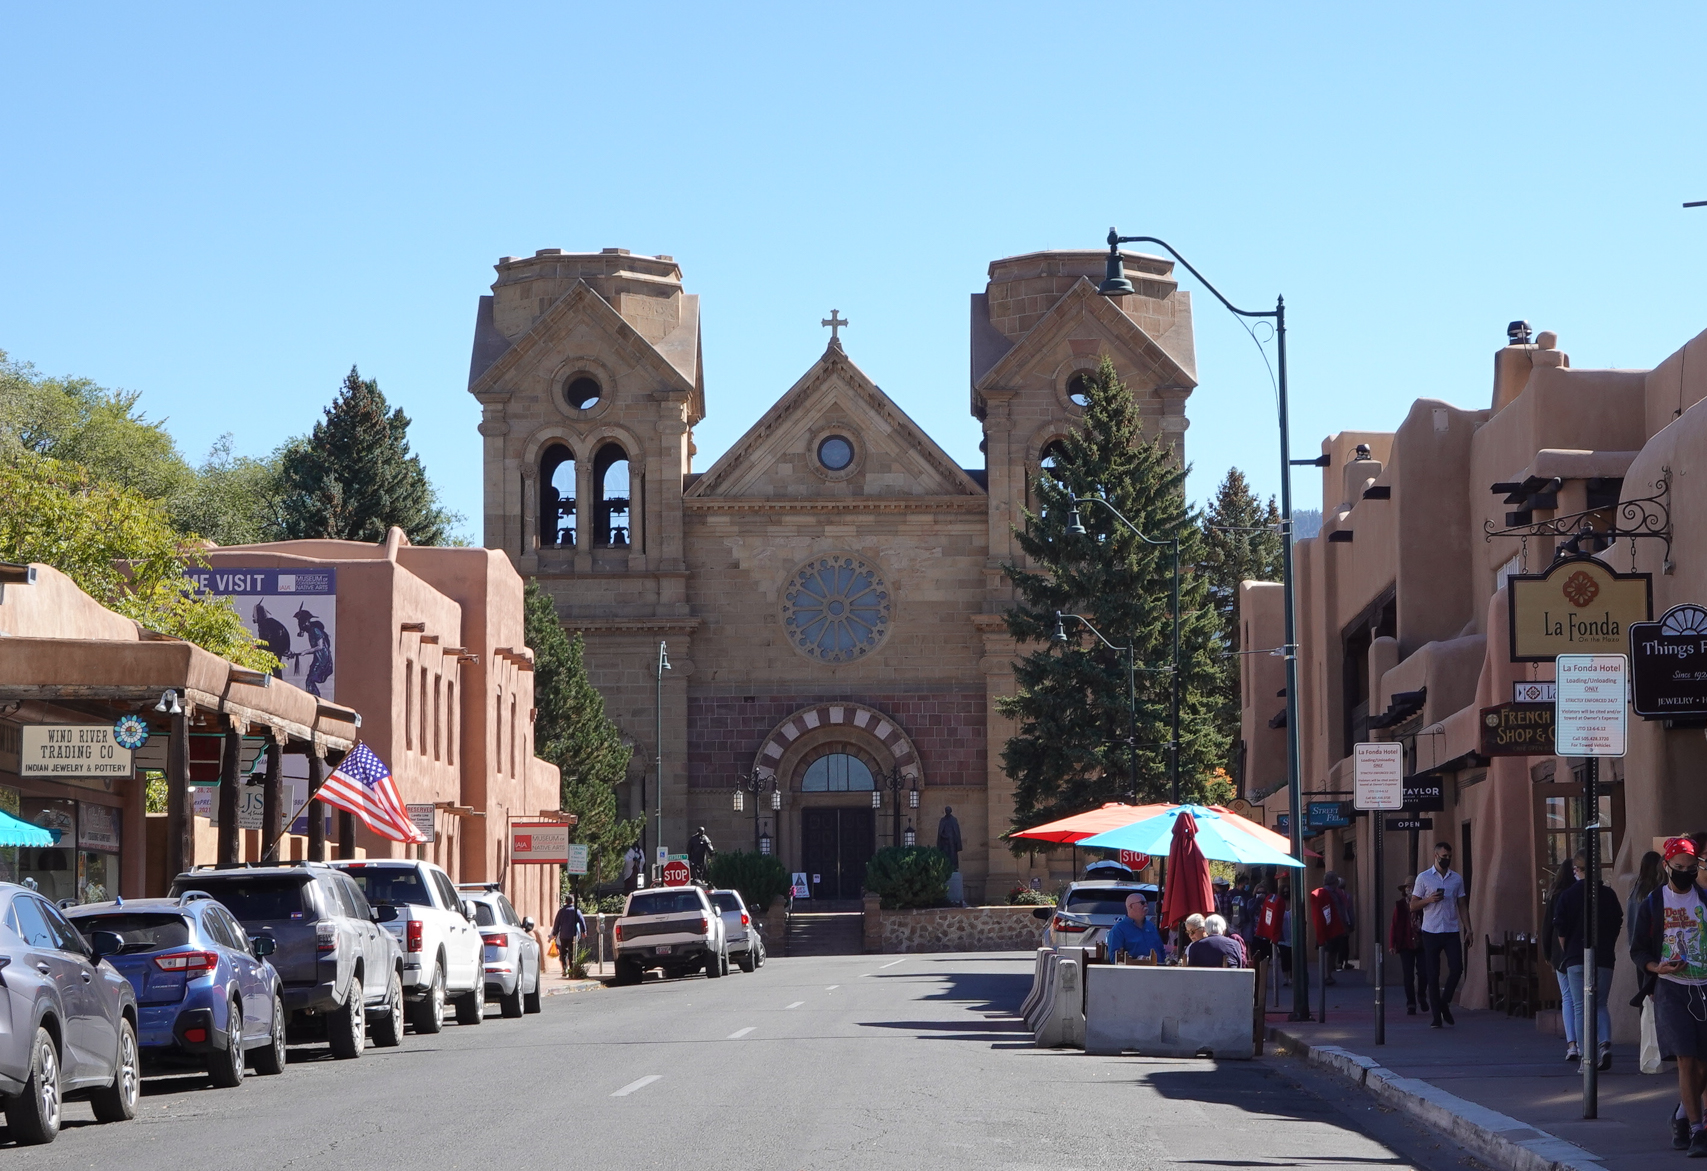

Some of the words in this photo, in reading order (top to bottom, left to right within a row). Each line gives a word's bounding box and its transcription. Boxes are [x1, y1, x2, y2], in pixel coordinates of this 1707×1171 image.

[216, 574, 265, 591] VISIT
[1544, 612, 1563, 636] La
[1568, 612, 1620, 641] Fonda
[1642, 640, 1694, 659] Things
[1574, 664, 1598, 672] Fonda
[1600, 664, 1621, 672] Hotel
[1673, 670, 1691, 679] Since
[1658, 697, 1693, 707] JEWELRY
[1501, 709, 1551, 727] FRENCH
[48, 729, 72, 743] WIND
[80, 729, 108, 743] RIVER
[1497, 726, 1533, 744] SHOP
[1536, 729, 1546, 742] &
[41, 745, 92, 759] TRADING
[100, 745, 113, 759] CO
[25, 764, 49, 772] INDIAN
[51, 764, 84, 772] JEWELRY
[86, 764, 92, 772] &
[95, 764, 127, 772] POTTERY
[1402, 788, 1440, 796] TAYLOR
[1312, 806, 1338, 815] STREET
[1122, 850, 1147, 862] STOP
[664, 870, 688, 881] STOP
